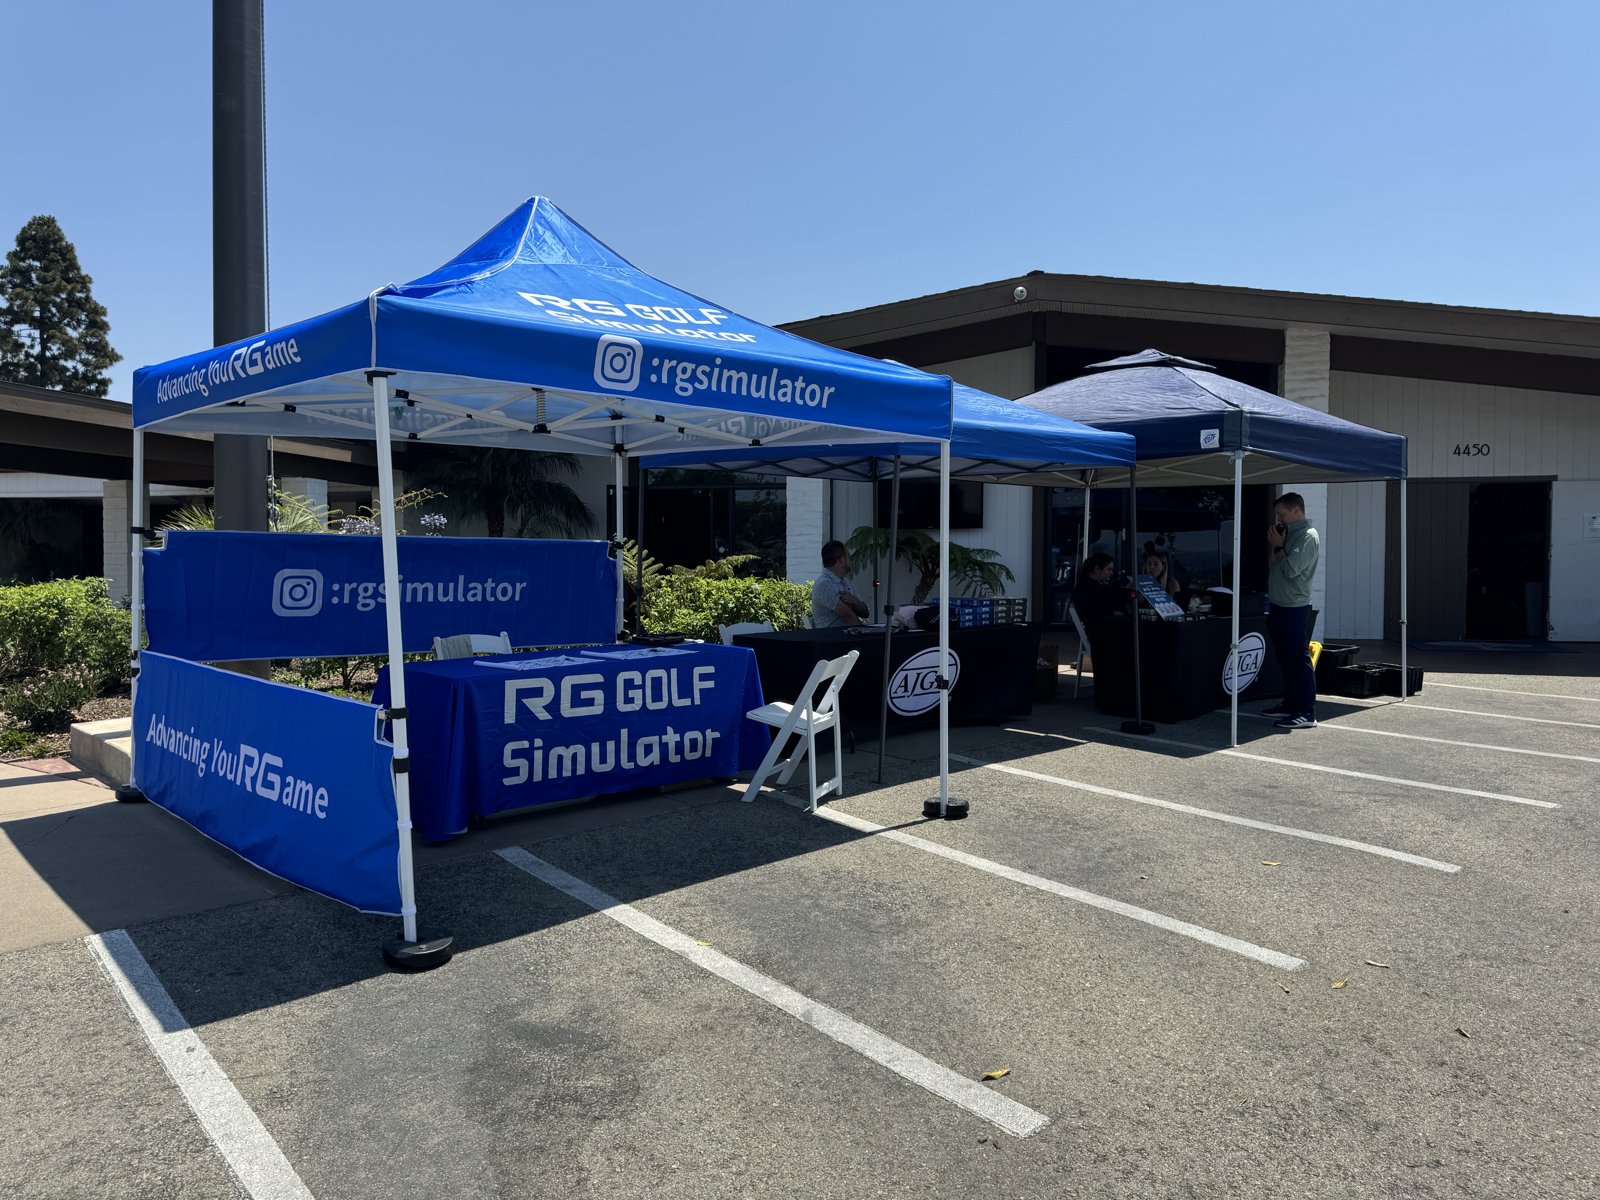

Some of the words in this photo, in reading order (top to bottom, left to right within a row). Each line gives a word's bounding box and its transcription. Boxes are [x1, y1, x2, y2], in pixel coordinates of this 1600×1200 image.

[516, 291, 628, 317] RG
[624, 303, 729, 325] GOLF
[545, 310, 757, 343] Simulator
[157, 365, 209, 404] Advancing
[1452, 443, 1491, 457] 4450
[504, 673, 605, 724] RG
[616, 665, 716, 713] GOLF
[893, 670, 945, 698] AJG
[146, 713, 211, 777] Advancing
[502, 725, 721, 786] Simulator
